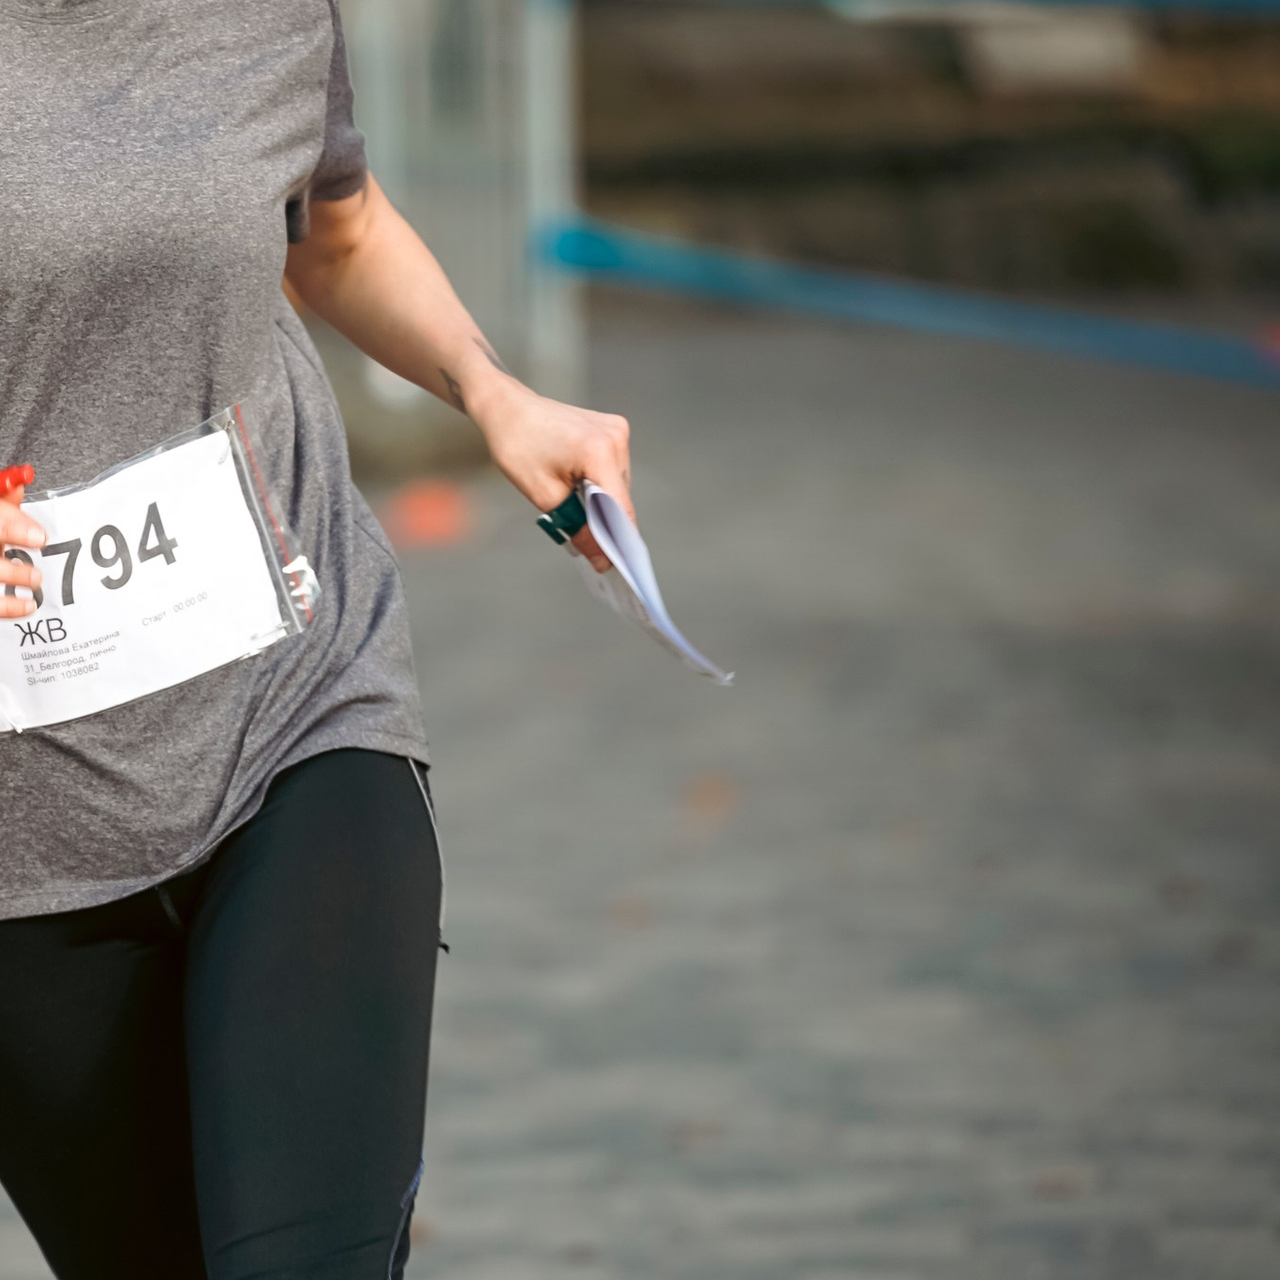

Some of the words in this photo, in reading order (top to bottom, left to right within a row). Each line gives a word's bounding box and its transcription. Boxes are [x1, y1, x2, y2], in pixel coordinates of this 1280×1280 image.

[14, 617, 67, 647] ЖВ
[72, 630, 120, 652] Екатерина
[89, 644, 117, 660] лично
[61, 662, 100, 679] 1038082
